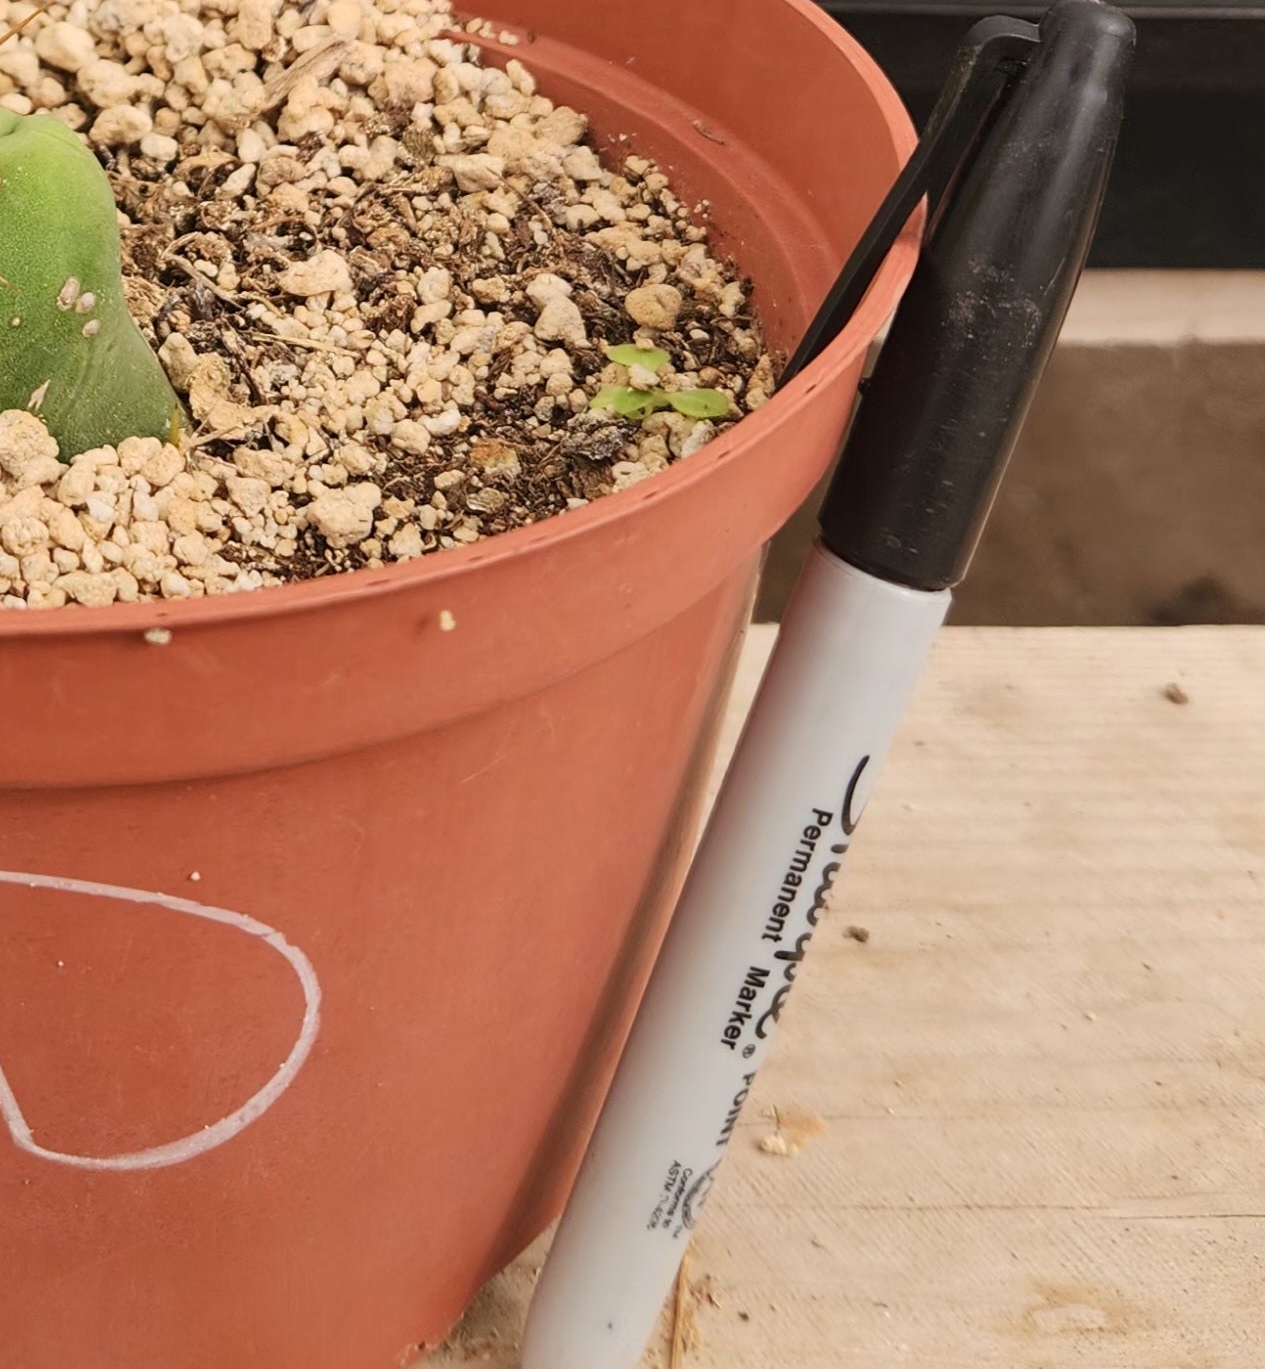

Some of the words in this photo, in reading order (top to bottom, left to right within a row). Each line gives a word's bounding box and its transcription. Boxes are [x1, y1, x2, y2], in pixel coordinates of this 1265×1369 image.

[761, 807, 834, 944] Permanent
[721, 965, 771, 1051] Marker
[663, 1159, 682, 1193] ASTM
